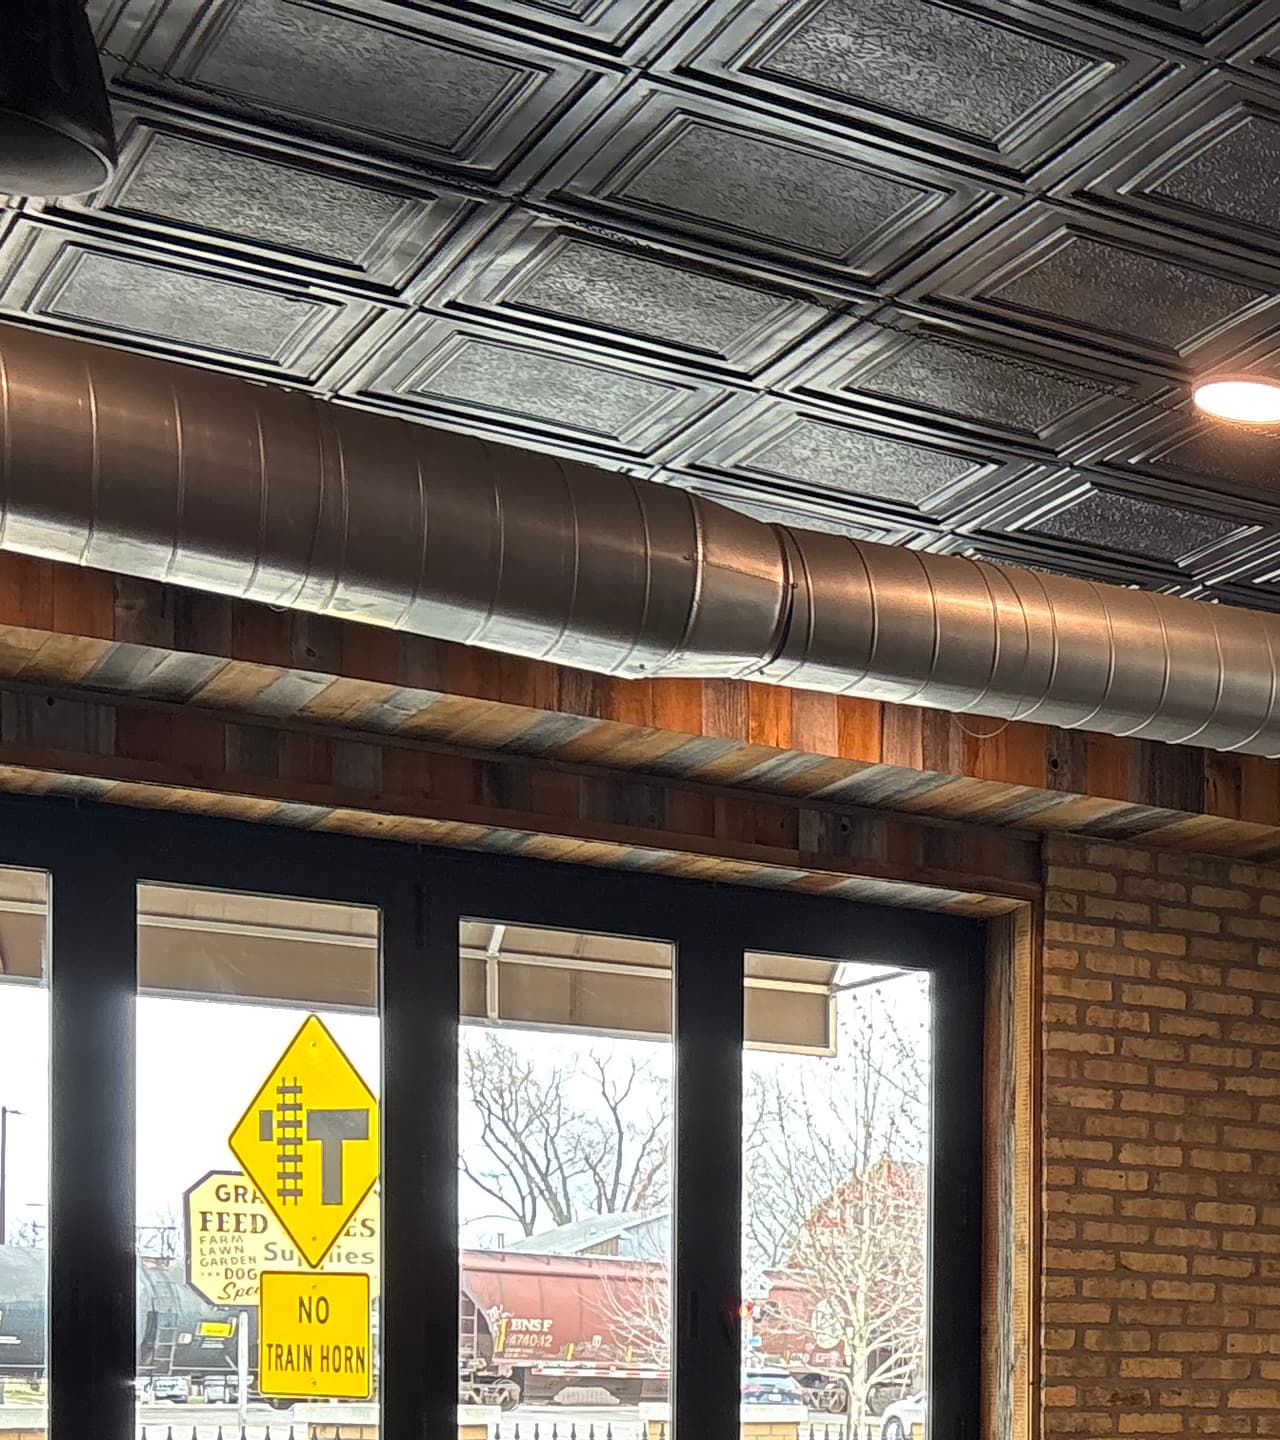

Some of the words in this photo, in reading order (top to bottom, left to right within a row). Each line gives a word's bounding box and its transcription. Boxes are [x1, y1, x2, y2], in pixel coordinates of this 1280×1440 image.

[199, 1211, 268, 1234] FEED
[200, 1235, 243, 1245] FARM
[200, 1245, 244, 1256] LAWN
[200, 1256, 256, 1267] GARDEN
[224, 1268, 258, 1280] DOG
[298, 1295, 329, 1324] NO
[511, 1318, 553, 1332] BNSF
[266, 1344, 312, 1372] TRAIN
[320, 1344, 365, 1374] HORN
